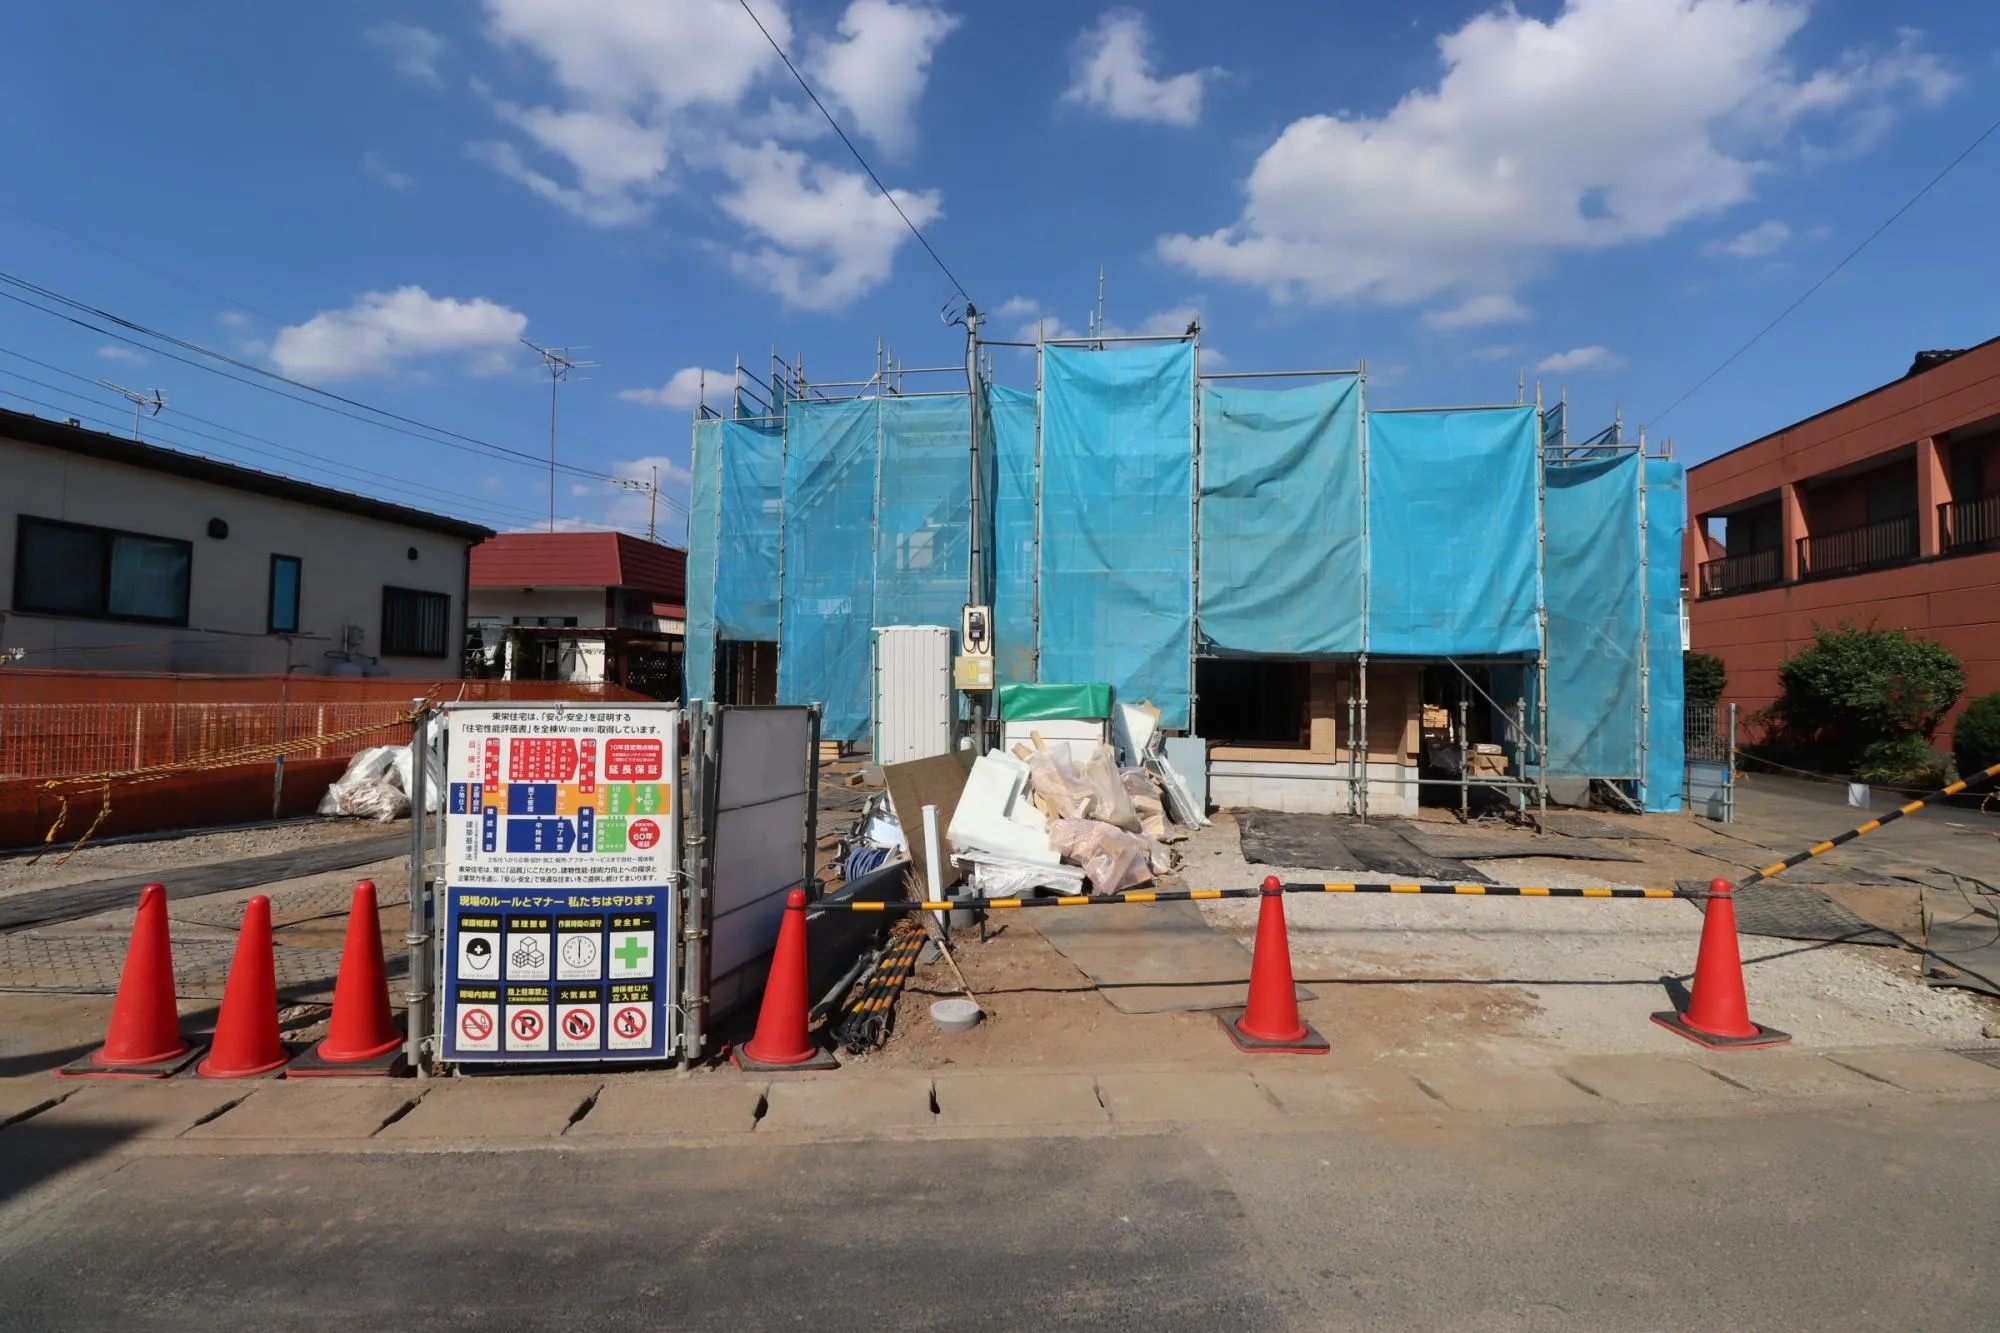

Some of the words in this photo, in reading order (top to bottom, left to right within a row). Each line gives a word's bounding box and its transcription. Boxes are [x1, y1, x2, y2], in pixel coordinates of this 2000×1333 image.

[459, 895, 565, 907] 現場のルールとマナー
[568, 895, 655, 907] 私たちは守ります
[614, 918, 650, 927] 安全第一
[612, 985, 648, 993] 関係者以外
[561, 991, 597, 999] 火気厳禁
[612, 993, 648, 1002] 立入禁止
